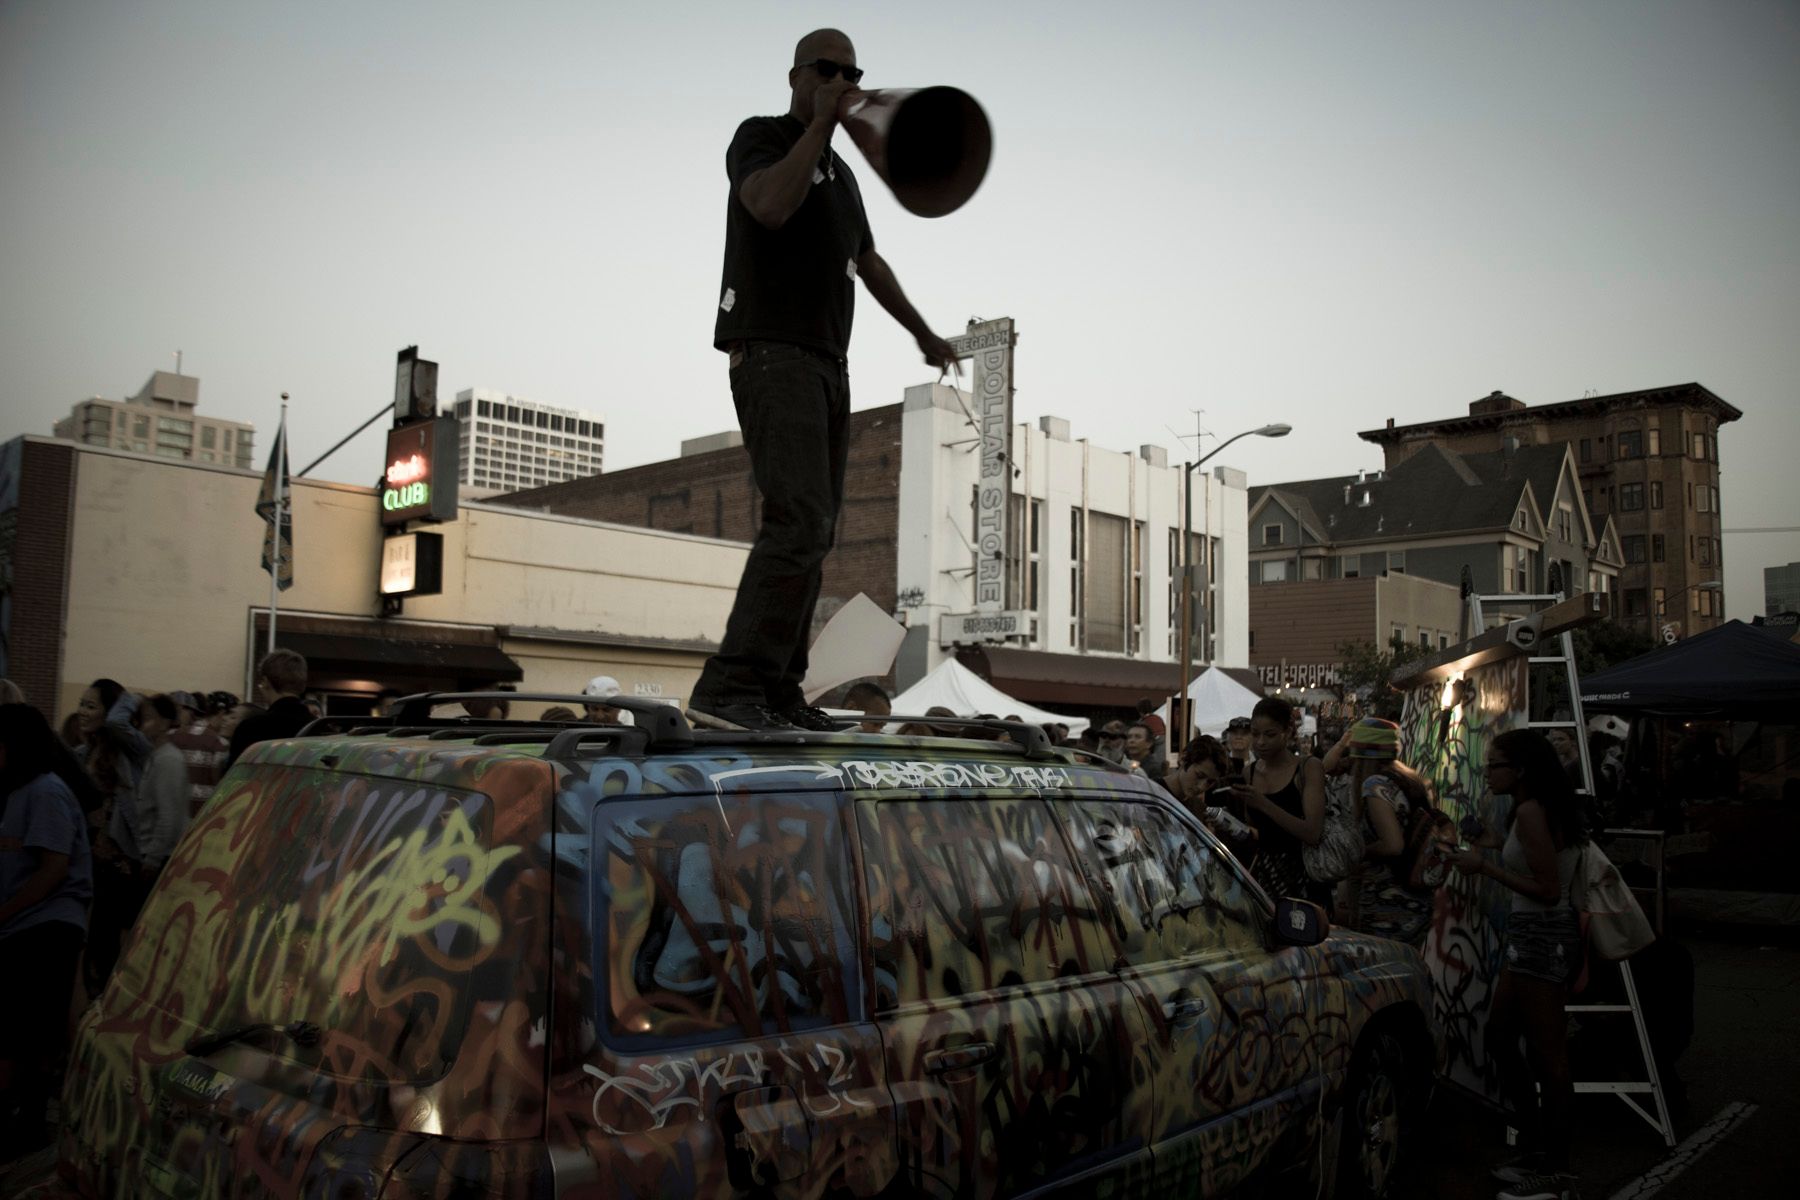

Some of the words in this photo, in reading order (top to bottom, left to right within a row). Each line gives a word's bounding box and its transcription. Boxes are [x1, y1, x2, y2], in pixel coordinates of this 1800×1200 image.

[951, 330, 1010, 353] ELEGRAPH
[982, 349, 1005, 479] DOLLAR
[383, 482, 426, 510] CLUB
[980, 488, 1003, 603] STORE
